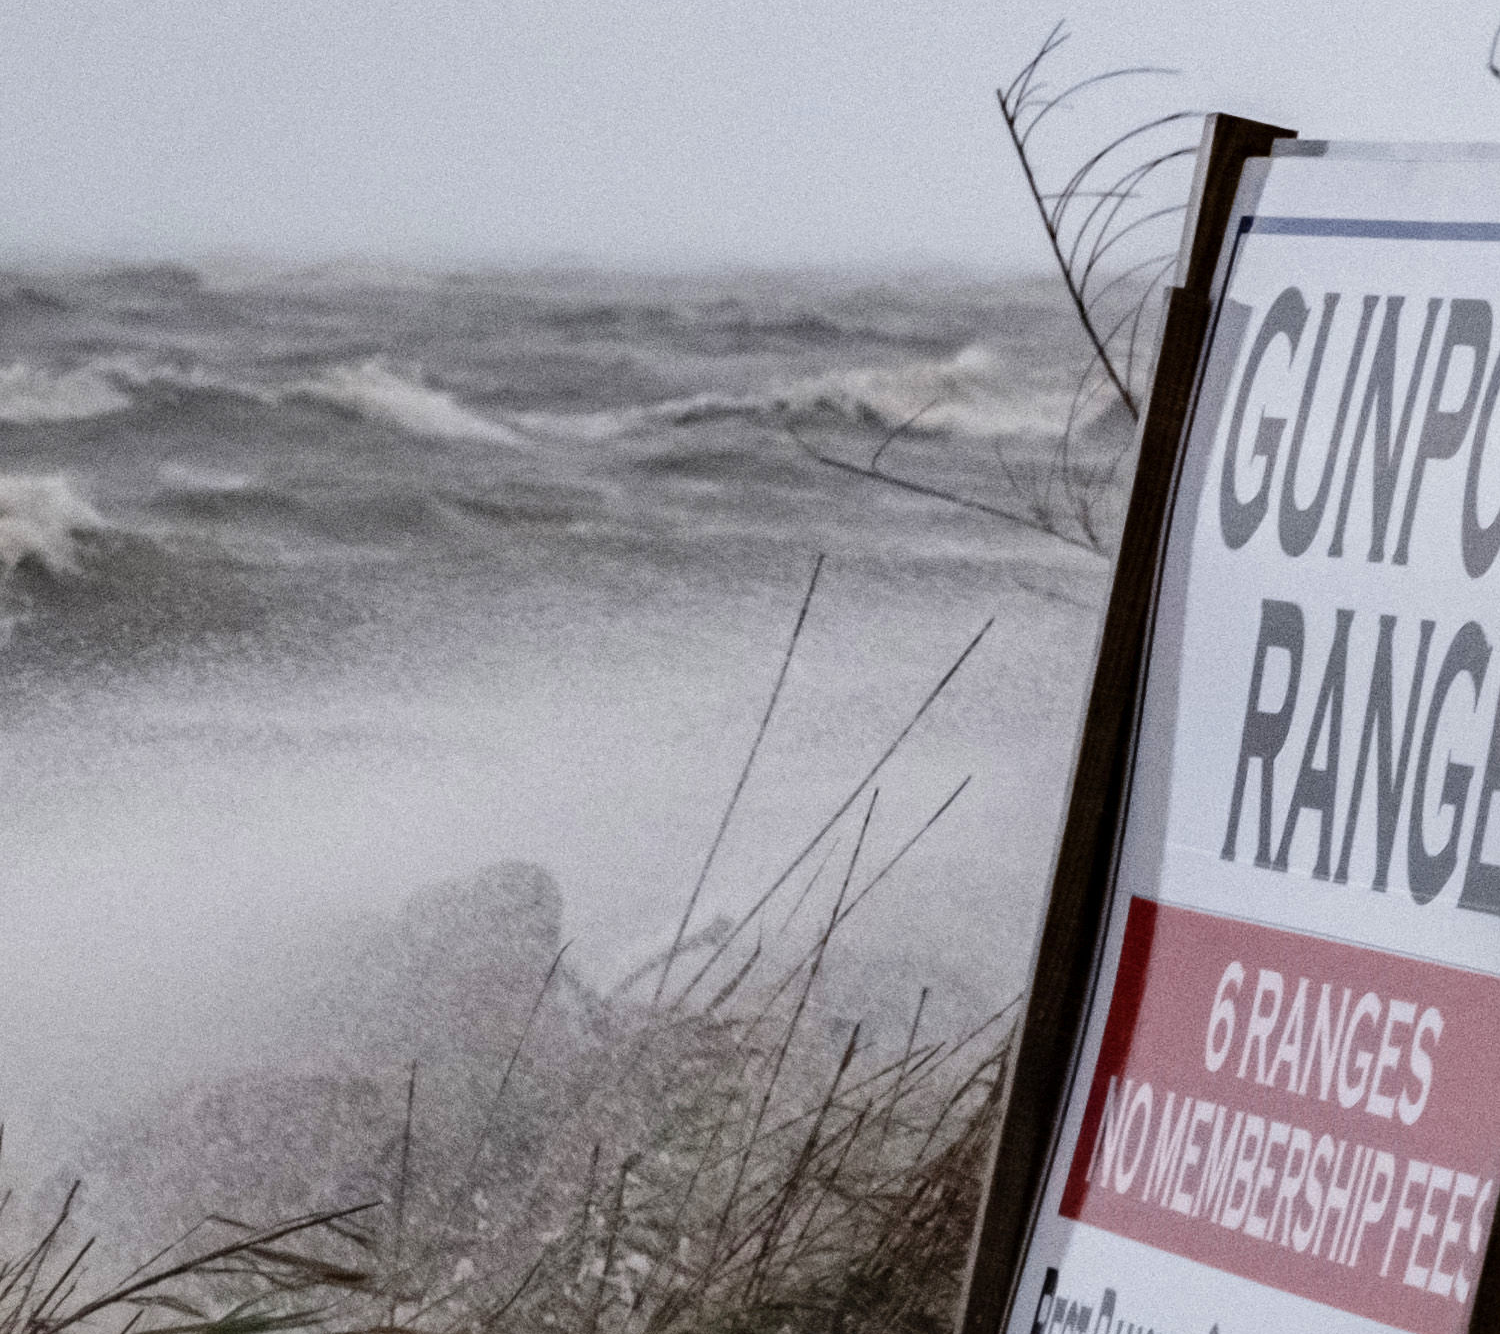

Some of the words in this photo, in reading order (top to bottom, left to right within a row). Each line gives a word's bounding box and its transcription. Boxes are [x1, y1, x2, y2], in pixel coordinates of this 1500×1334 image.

[1205, 960, 1245, 1073] 6
[1236, 969, 1446, 1127] RANGES
[1085, 1075, 1154, 1195] NO
[1141, 1090, 1396, 1268] MEMBERSHIP
[1379, 1158, 1494, 1305] FEES
